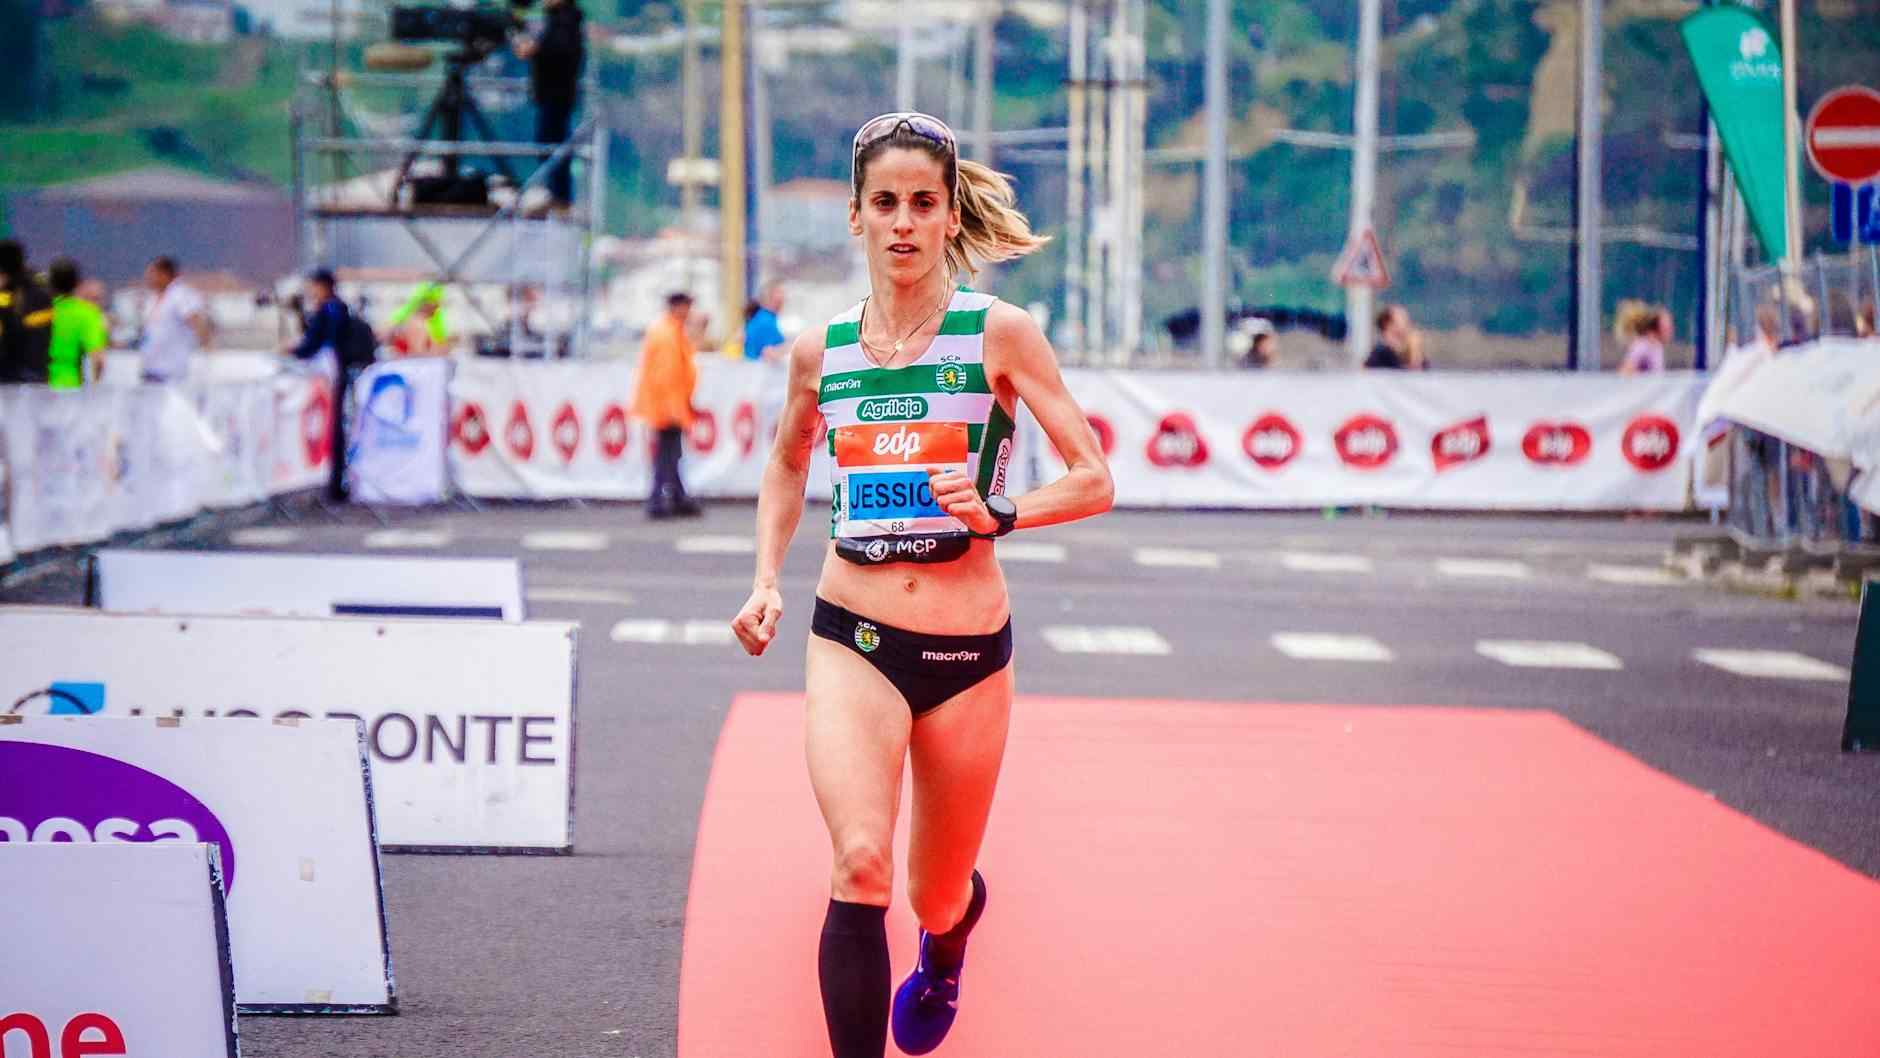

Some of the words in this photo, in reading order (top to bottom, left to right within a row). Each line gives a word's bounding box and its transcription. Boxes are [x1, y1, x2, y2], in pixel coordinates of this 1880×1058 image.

[863, 399, 921, 419] Agriloja
[873, 425, 920, 462] edp
[993, 444, 1009, 496] Agrilo
[851, 481, 939, 510] JESSIC
[891, 522, 905, 533] 68
[896, 539, 937, 554] MCP
